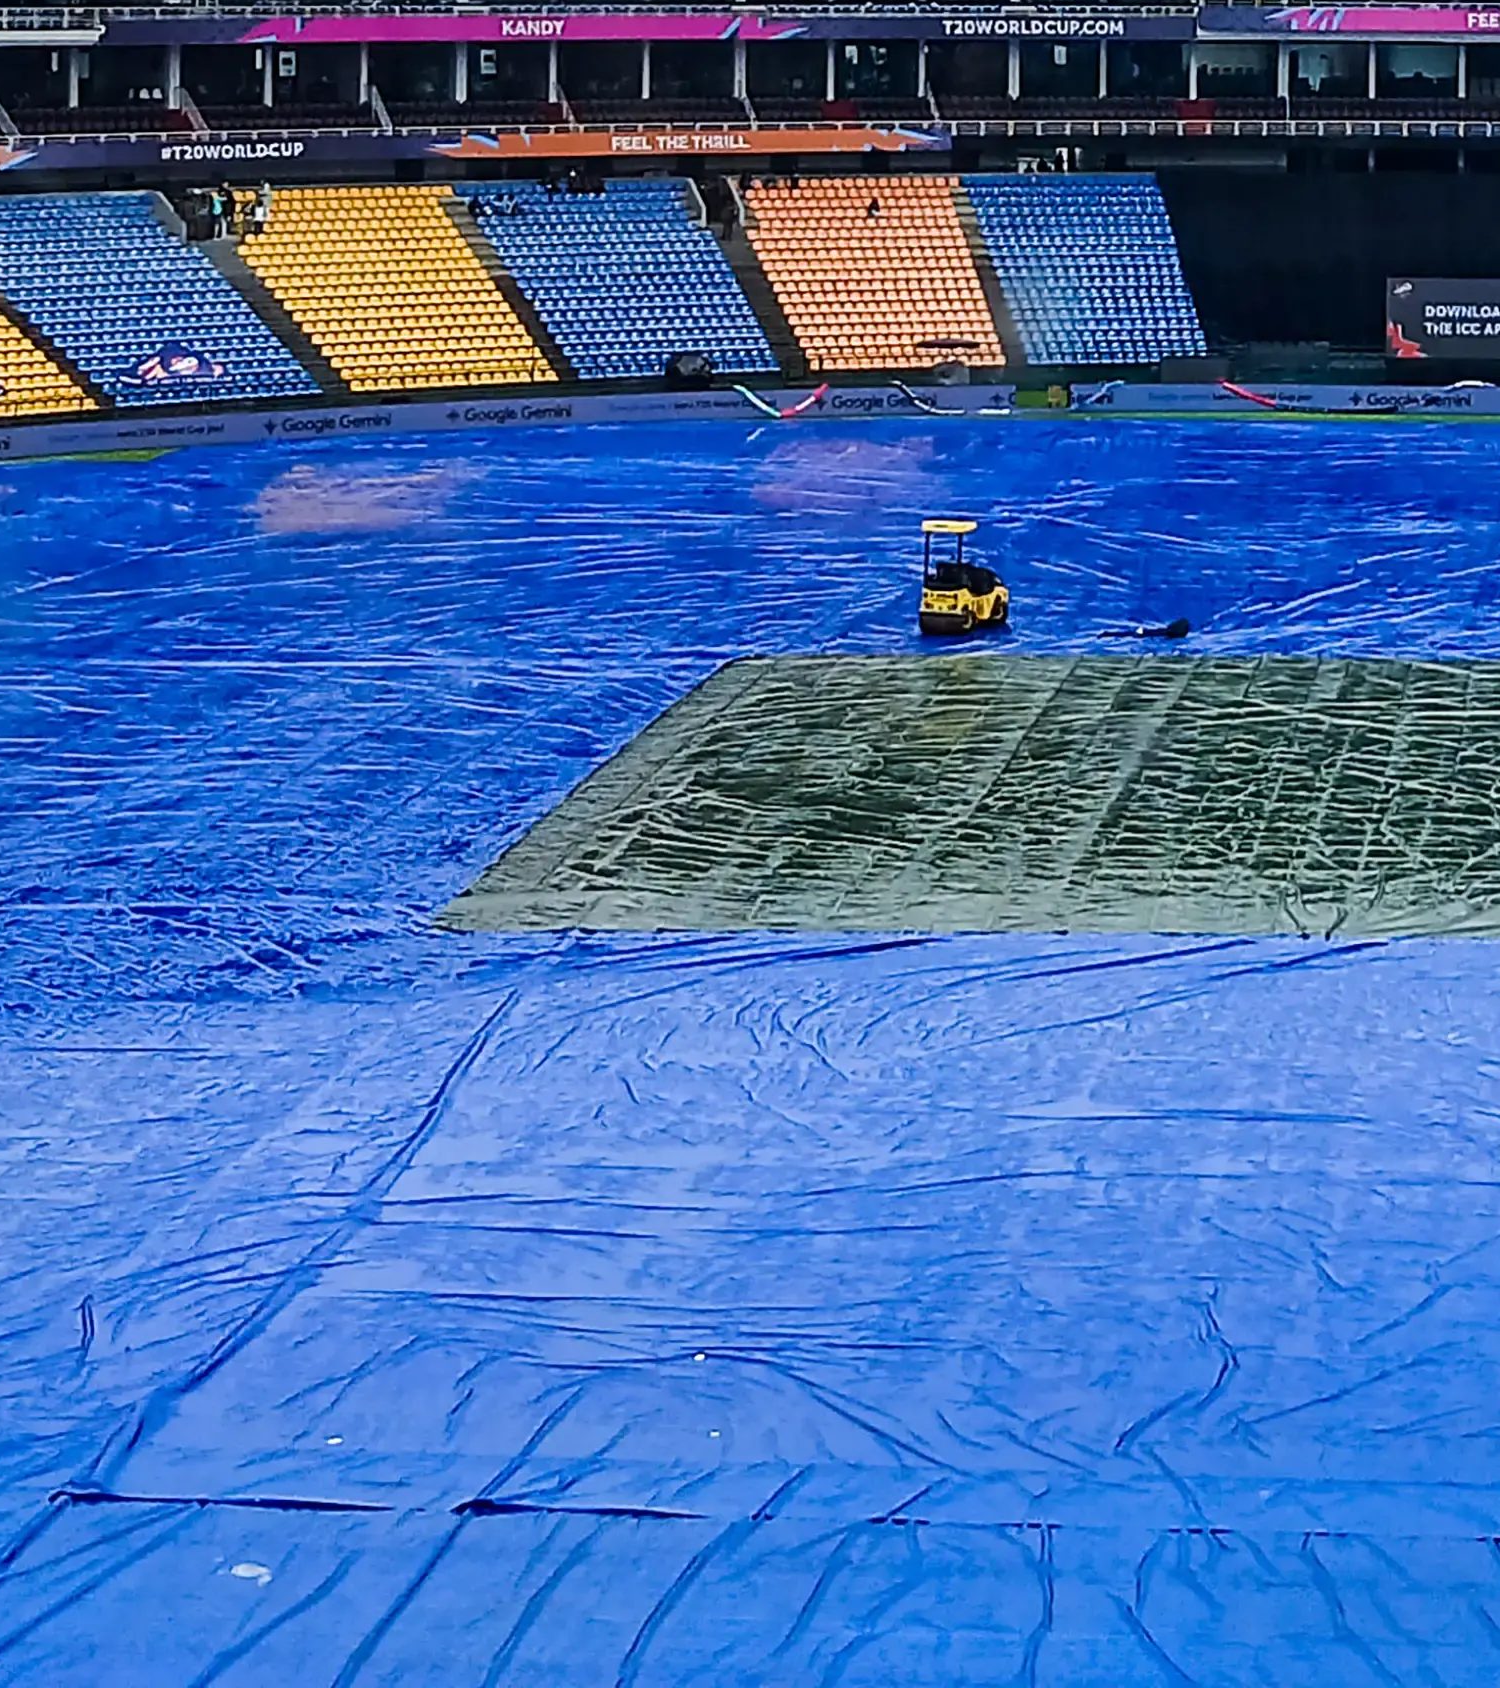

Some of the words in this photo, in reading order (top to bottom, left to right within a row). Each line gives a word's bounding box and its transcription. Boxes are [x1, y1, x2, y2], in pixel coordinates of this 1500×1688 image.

[502, 19, 565, 36] KANDY
[611, 135, 652, 151] FEEL
[655, 135, 690, 150] THE
[691, 134, 751, 150] THRILL
[1423, 322, 1453, 335] THE
[1455, 322, 1481, 335] ICC
